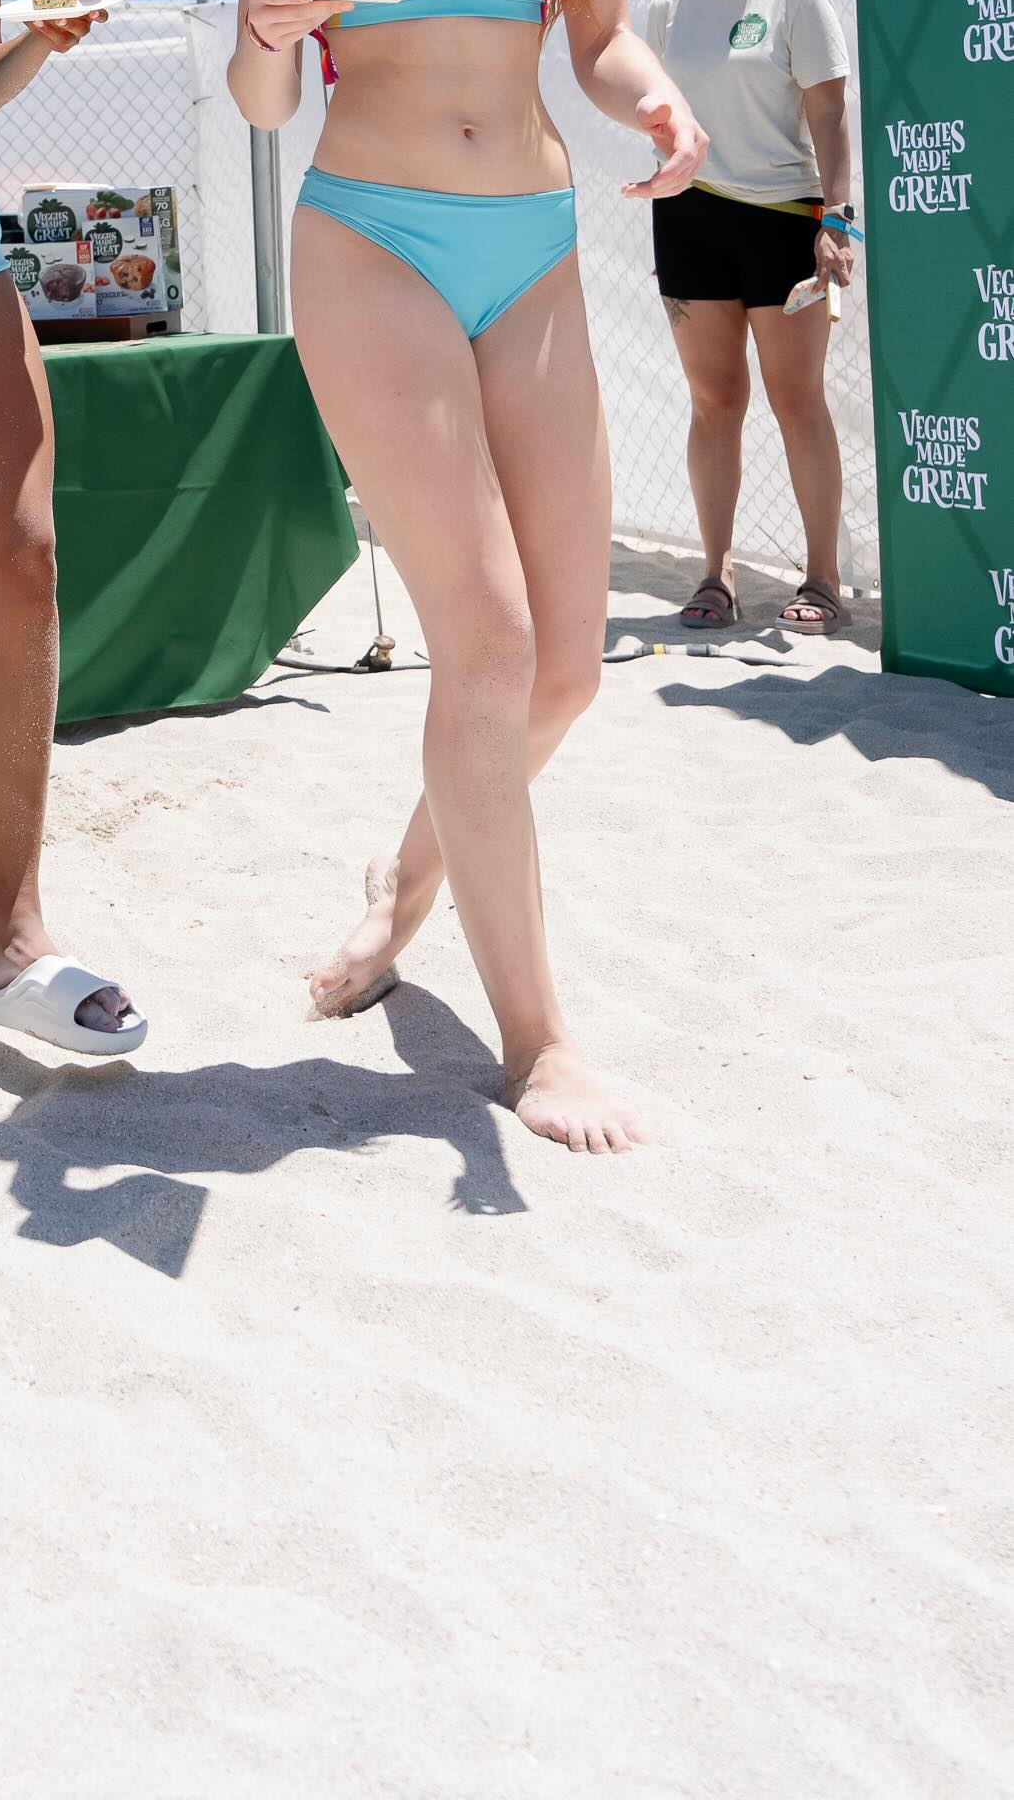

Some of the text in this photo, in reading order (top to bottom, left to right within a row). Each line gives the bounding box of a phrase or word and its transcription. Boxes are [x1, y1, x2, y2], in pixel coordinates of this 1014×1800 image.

[885, 119, 966, 157] VEGGIES
[901, 149, 951, 173] MADE
[156, 202, 168, 210] 70
[889, 173, 972, 214] GREAT
[34, 211, 68, 224] VEGGIES
[34, 227, 73, 241] GREAT
[12, 272, 37, 282] REAT
[898, 409, 981, 451] VEGGIES
[915, 441, 965, 467] MADE
[902, 465, 988, 510] GREAT
